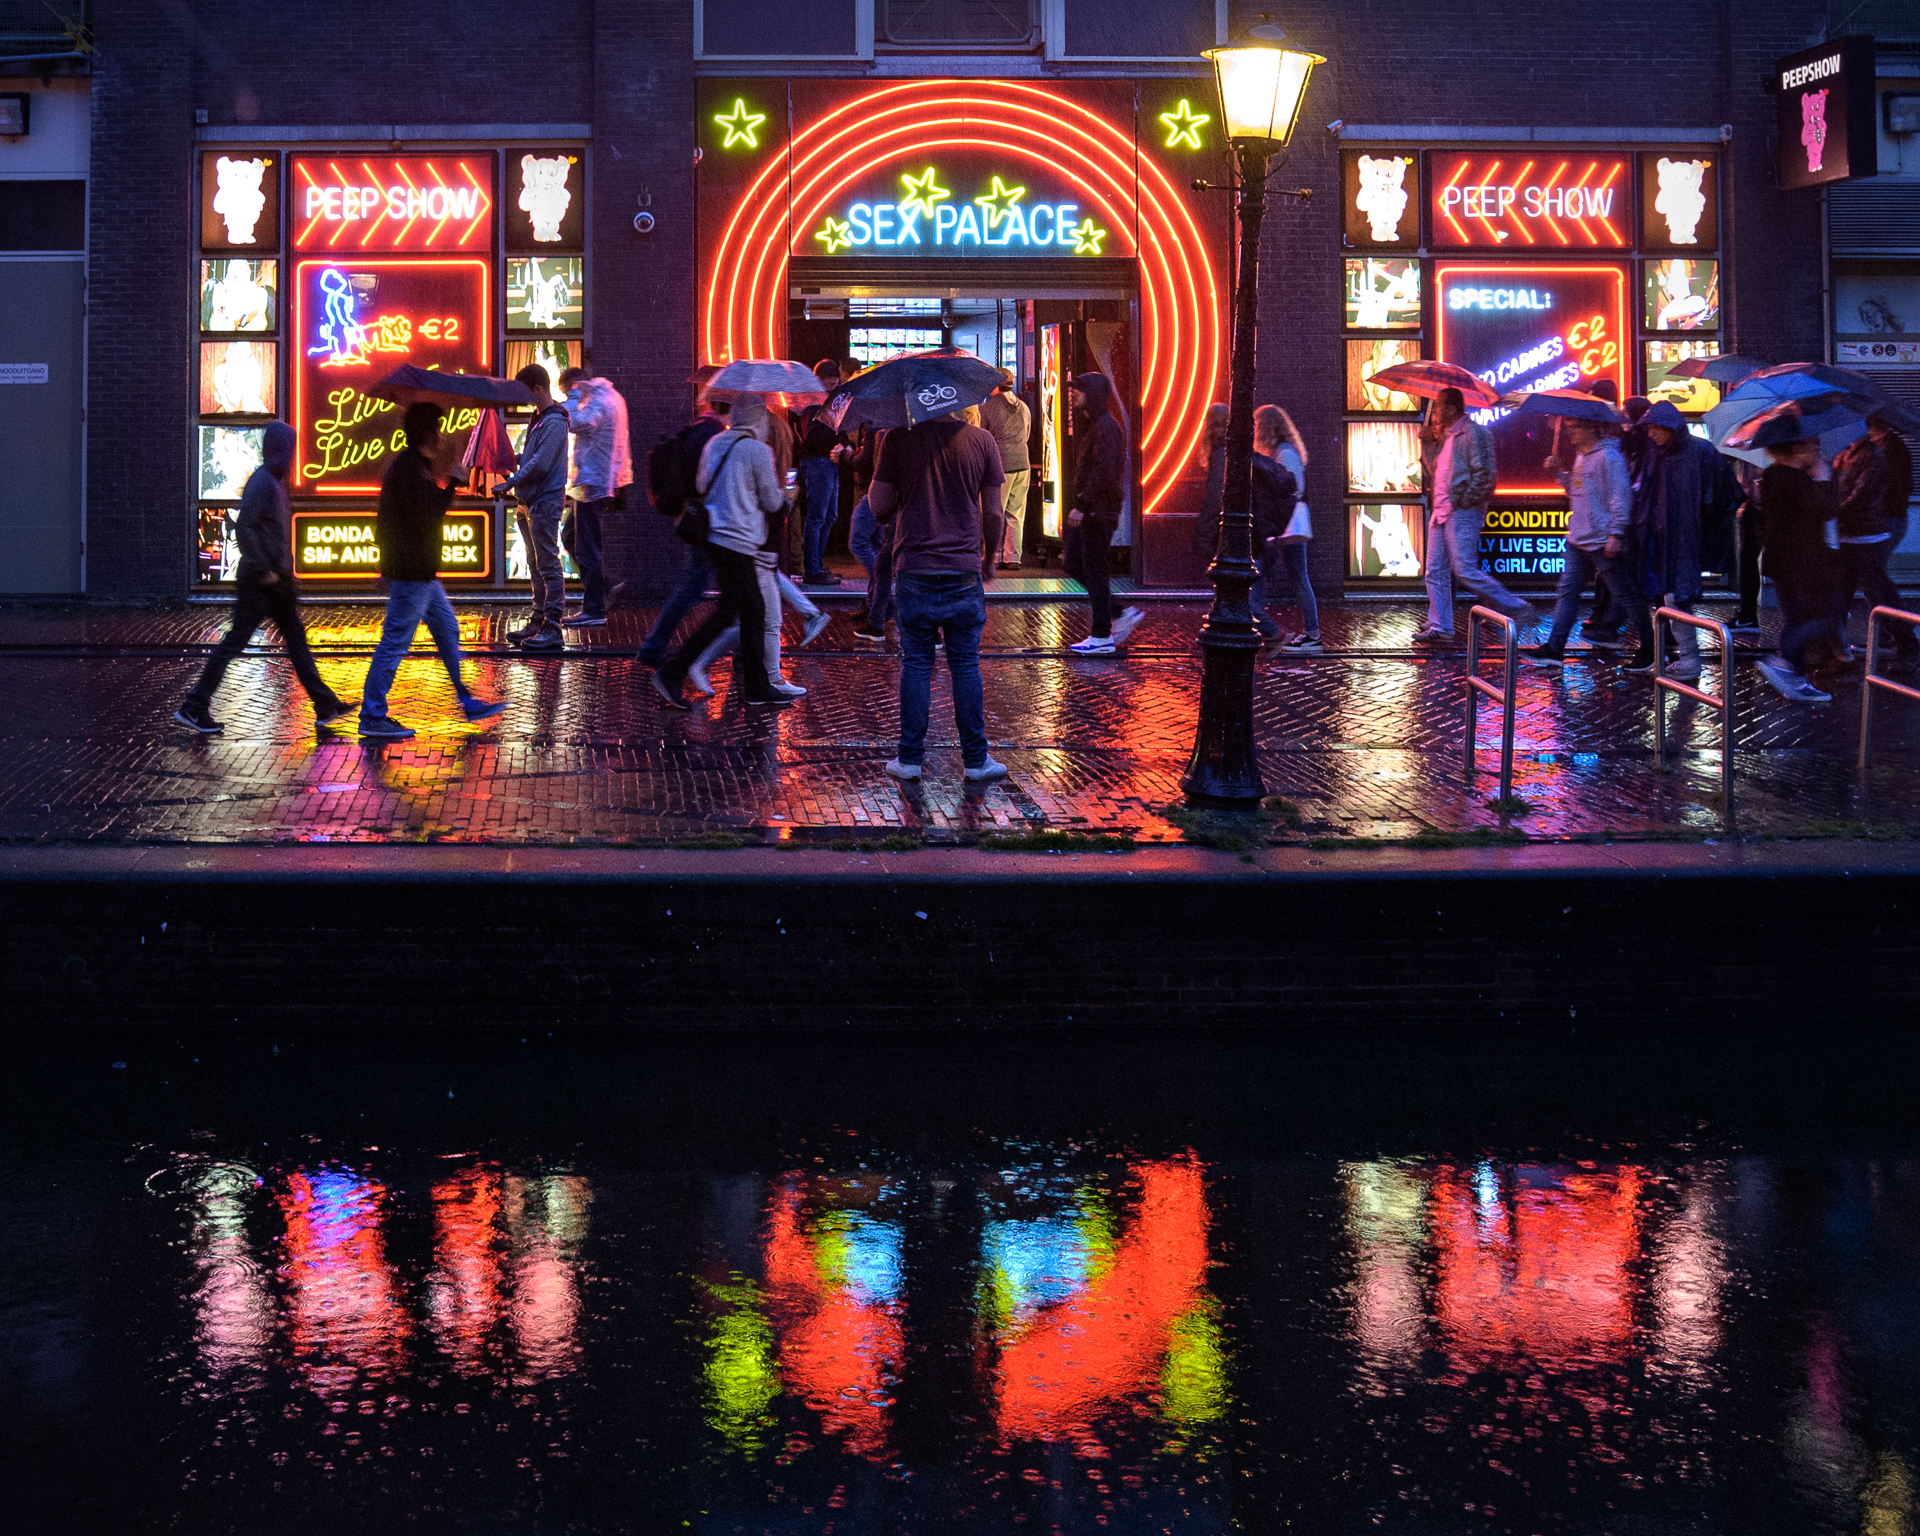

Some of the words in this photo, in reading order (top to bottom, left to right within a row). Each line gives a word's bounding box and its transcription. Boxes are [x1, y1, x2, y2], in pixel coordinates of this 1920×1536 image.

[1782, 53, 1840, 90] PEEPSHOW
[306, 186, 379, 219] PEEP
[387, 185, 479, 220] SHOW
[1443, 186, 1515, 217] PEEP
[1524, 186, 1614, 219] SHOW
[849, 203, 921, 245] SEX
[936, 203, 1079, 245] PALACE
[1449, 288, 1552, 310] SPECIAL:
[419, 318, 459, 341] €2
[1497, 336, 1563, 383] CABINES
[1567, 315, 1606, 349] €2
[1579, 341, 1618, 375] €2
[926, 399, 959, 411] AMSTERDAM
[303, 432, 385, 478] Live
[307, 526, 375, 543] BONDA
[1500, 538, 1533, 552] LIVE
[1536, 537, 1567, 553] SEX
[441, 545, 478, 563] SEX
[1480, 558, 1491, 573] &
